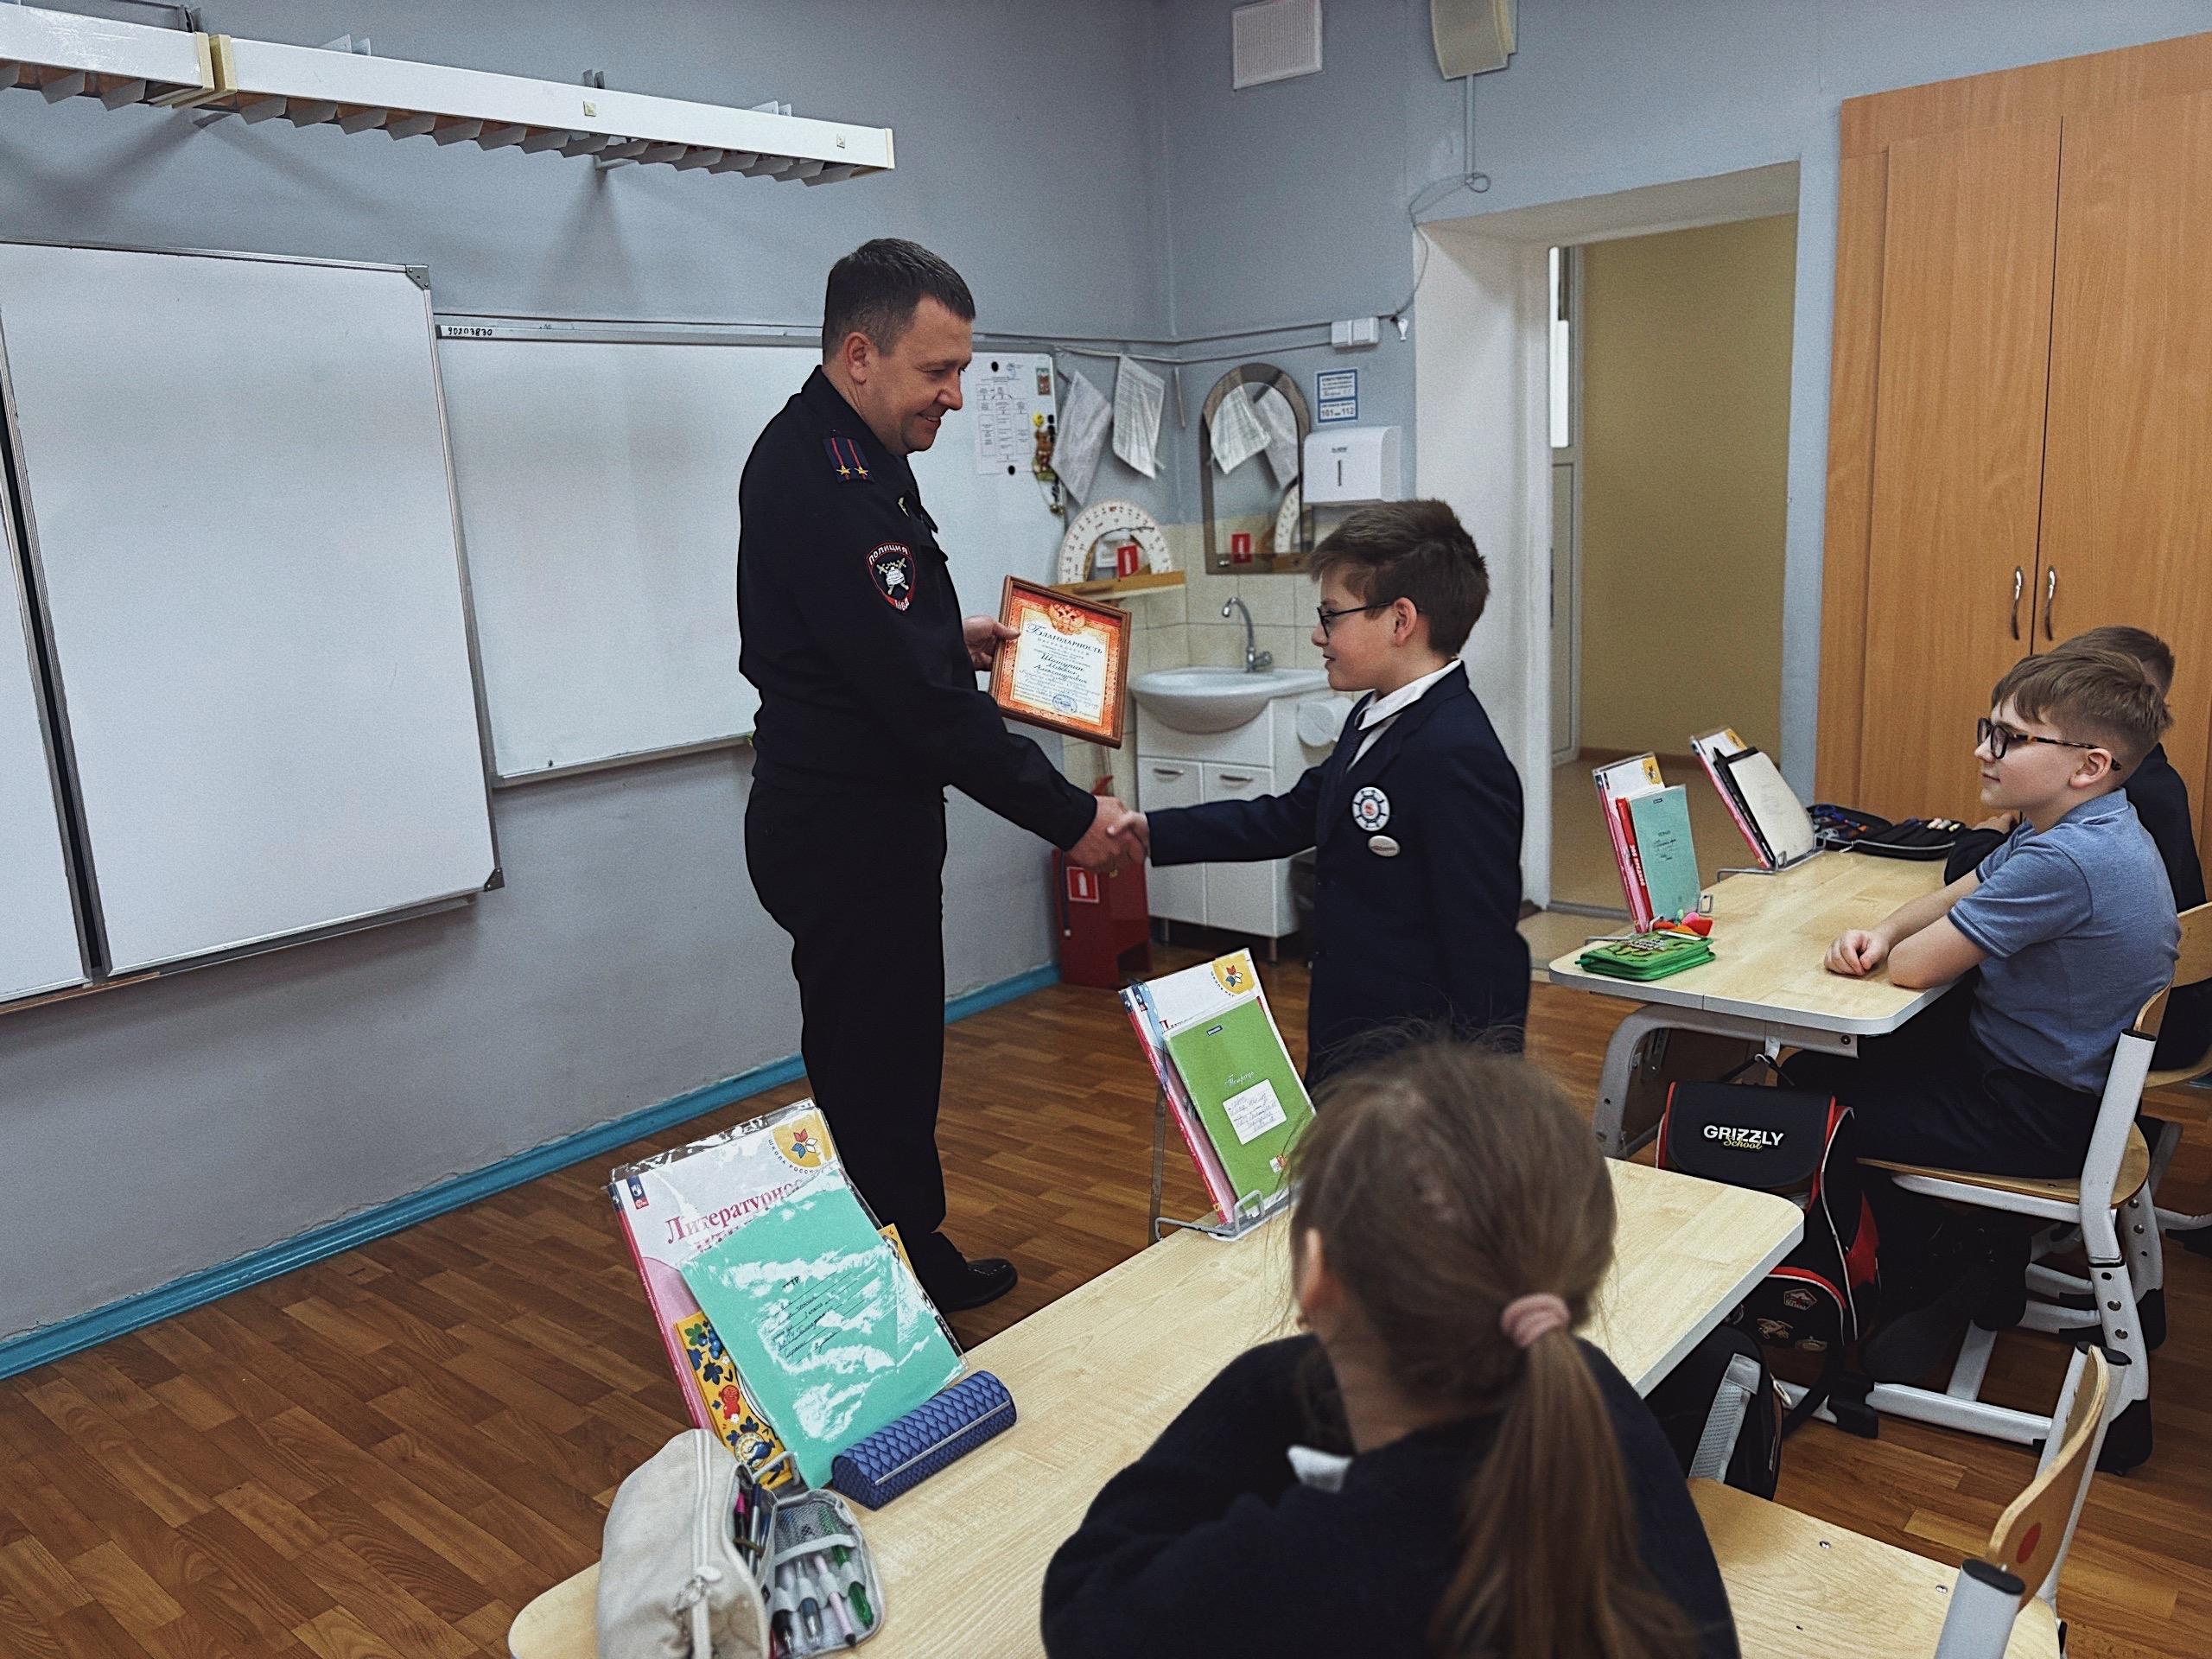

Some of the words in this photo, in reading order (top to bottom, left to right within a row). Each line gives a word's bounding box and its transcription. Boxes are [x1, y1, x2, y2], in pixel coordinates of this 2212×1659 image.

[448, 327, 493, 337] 90203830
[868, 544, 908, 565] ПОЛИЦИЯ
[1703, 1125, 1784, 1147] GRIZZLY
[1723, 1135, 1763, 1150] School
[768, 1139, 786, 1164] ШКОЛА
[789, 1164, 820, 1175] РОССИ
